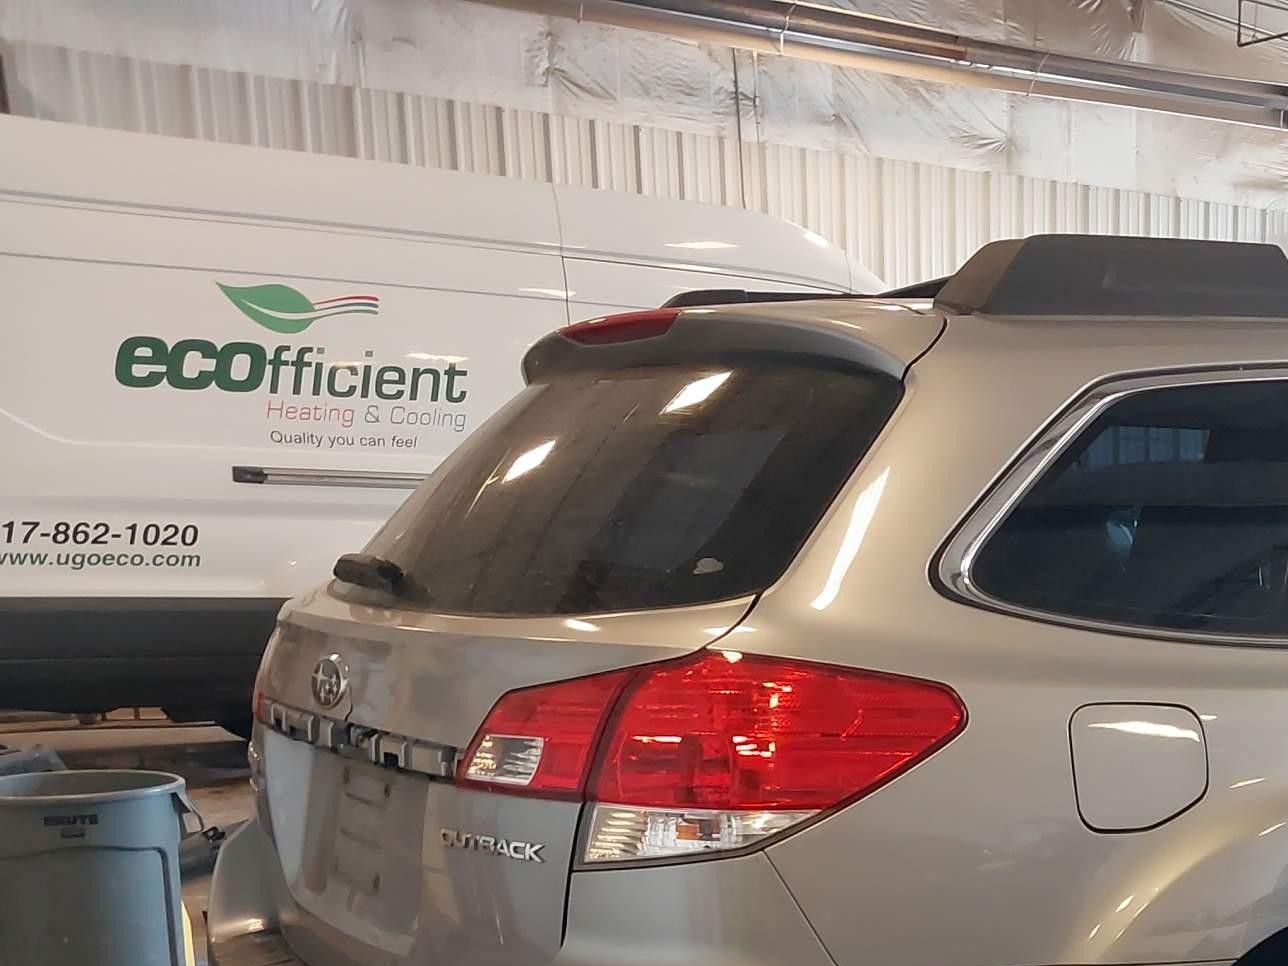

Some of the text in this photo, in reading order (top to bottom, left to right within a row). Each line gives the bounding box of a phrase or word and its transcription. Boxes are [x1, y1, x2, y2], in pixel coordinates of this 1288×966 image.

[115, 336, 468, 403] ecofficient
[266, 400, 466, 432] Heating & Cooling
[270, 430, 418, 448] Quality you can feel
[2, 520, 199, 546] 17-862-1020
[440, 828, 545, 863] OUTBACK
